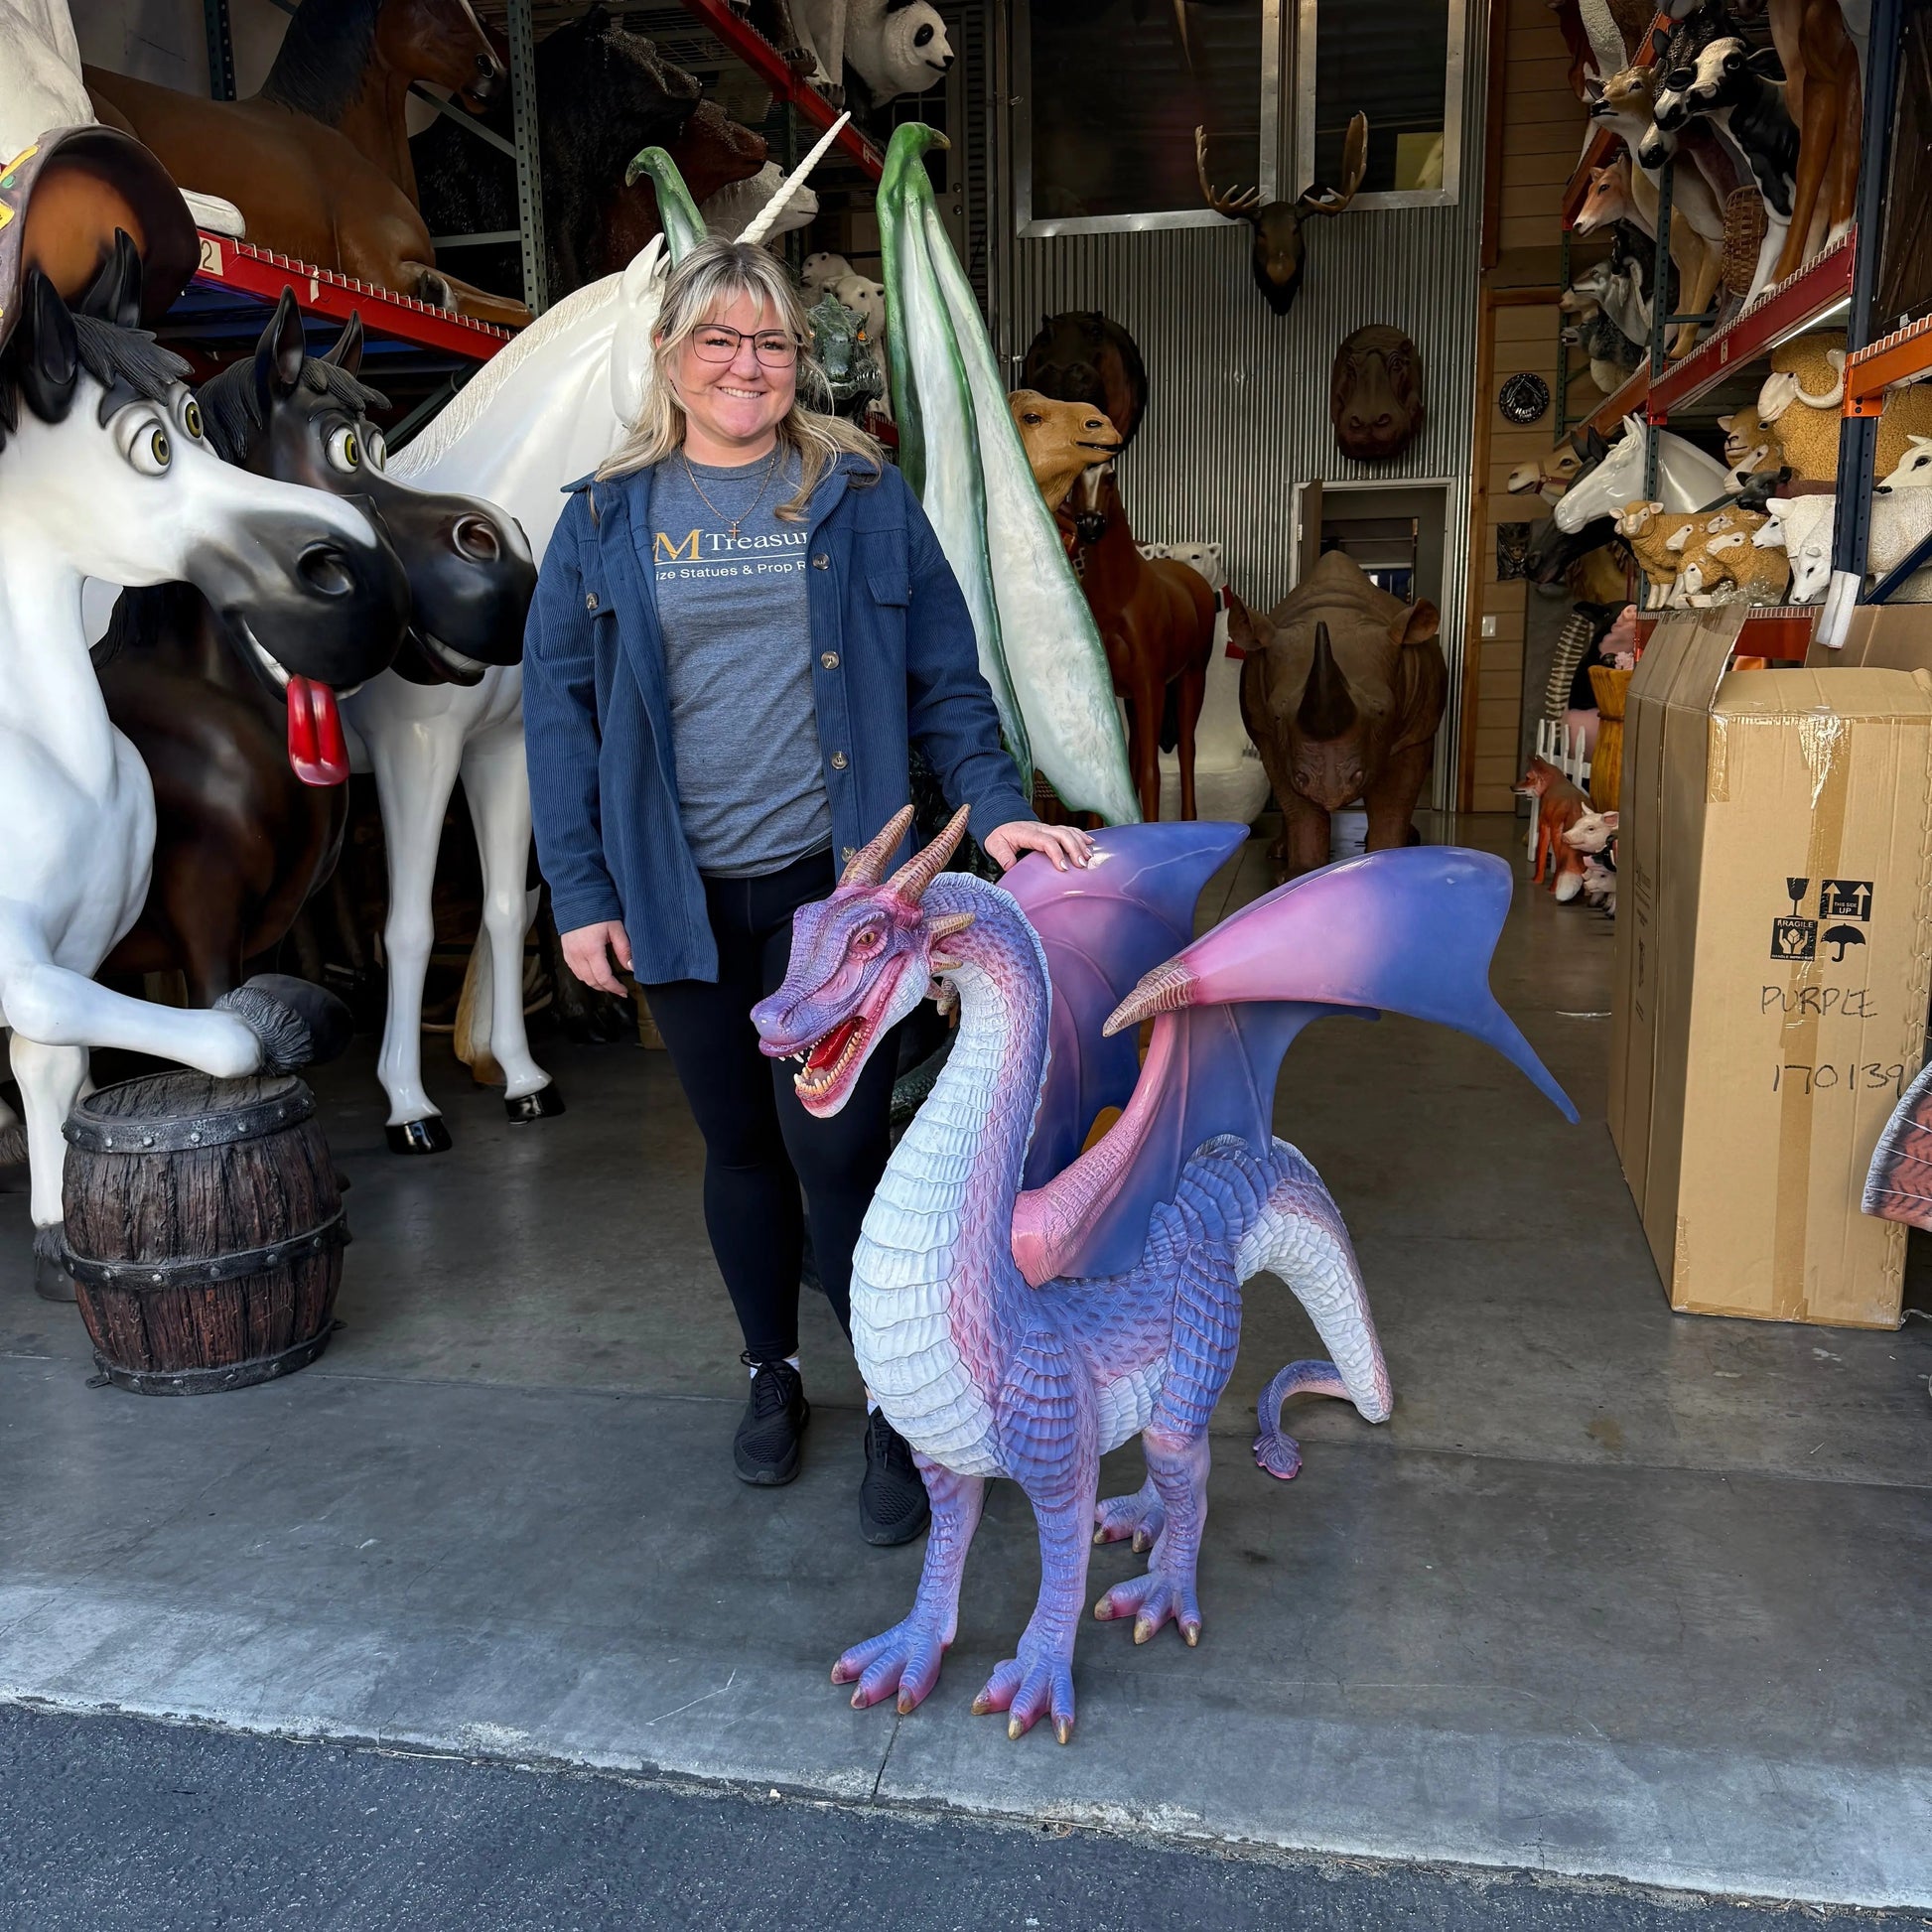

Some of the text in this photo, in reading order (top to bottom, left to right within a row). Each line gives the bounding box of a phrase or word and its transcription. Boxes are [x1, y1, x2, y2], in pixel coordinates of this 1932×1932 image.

[680, 566, 738, 579] Statues
[743, 565, 755, 576] &
[758, 563, 793, 574] Prop
[1761, 985, 1877, 1018] PURPLE
[1773, 1063, 1904, 1098] 170139
